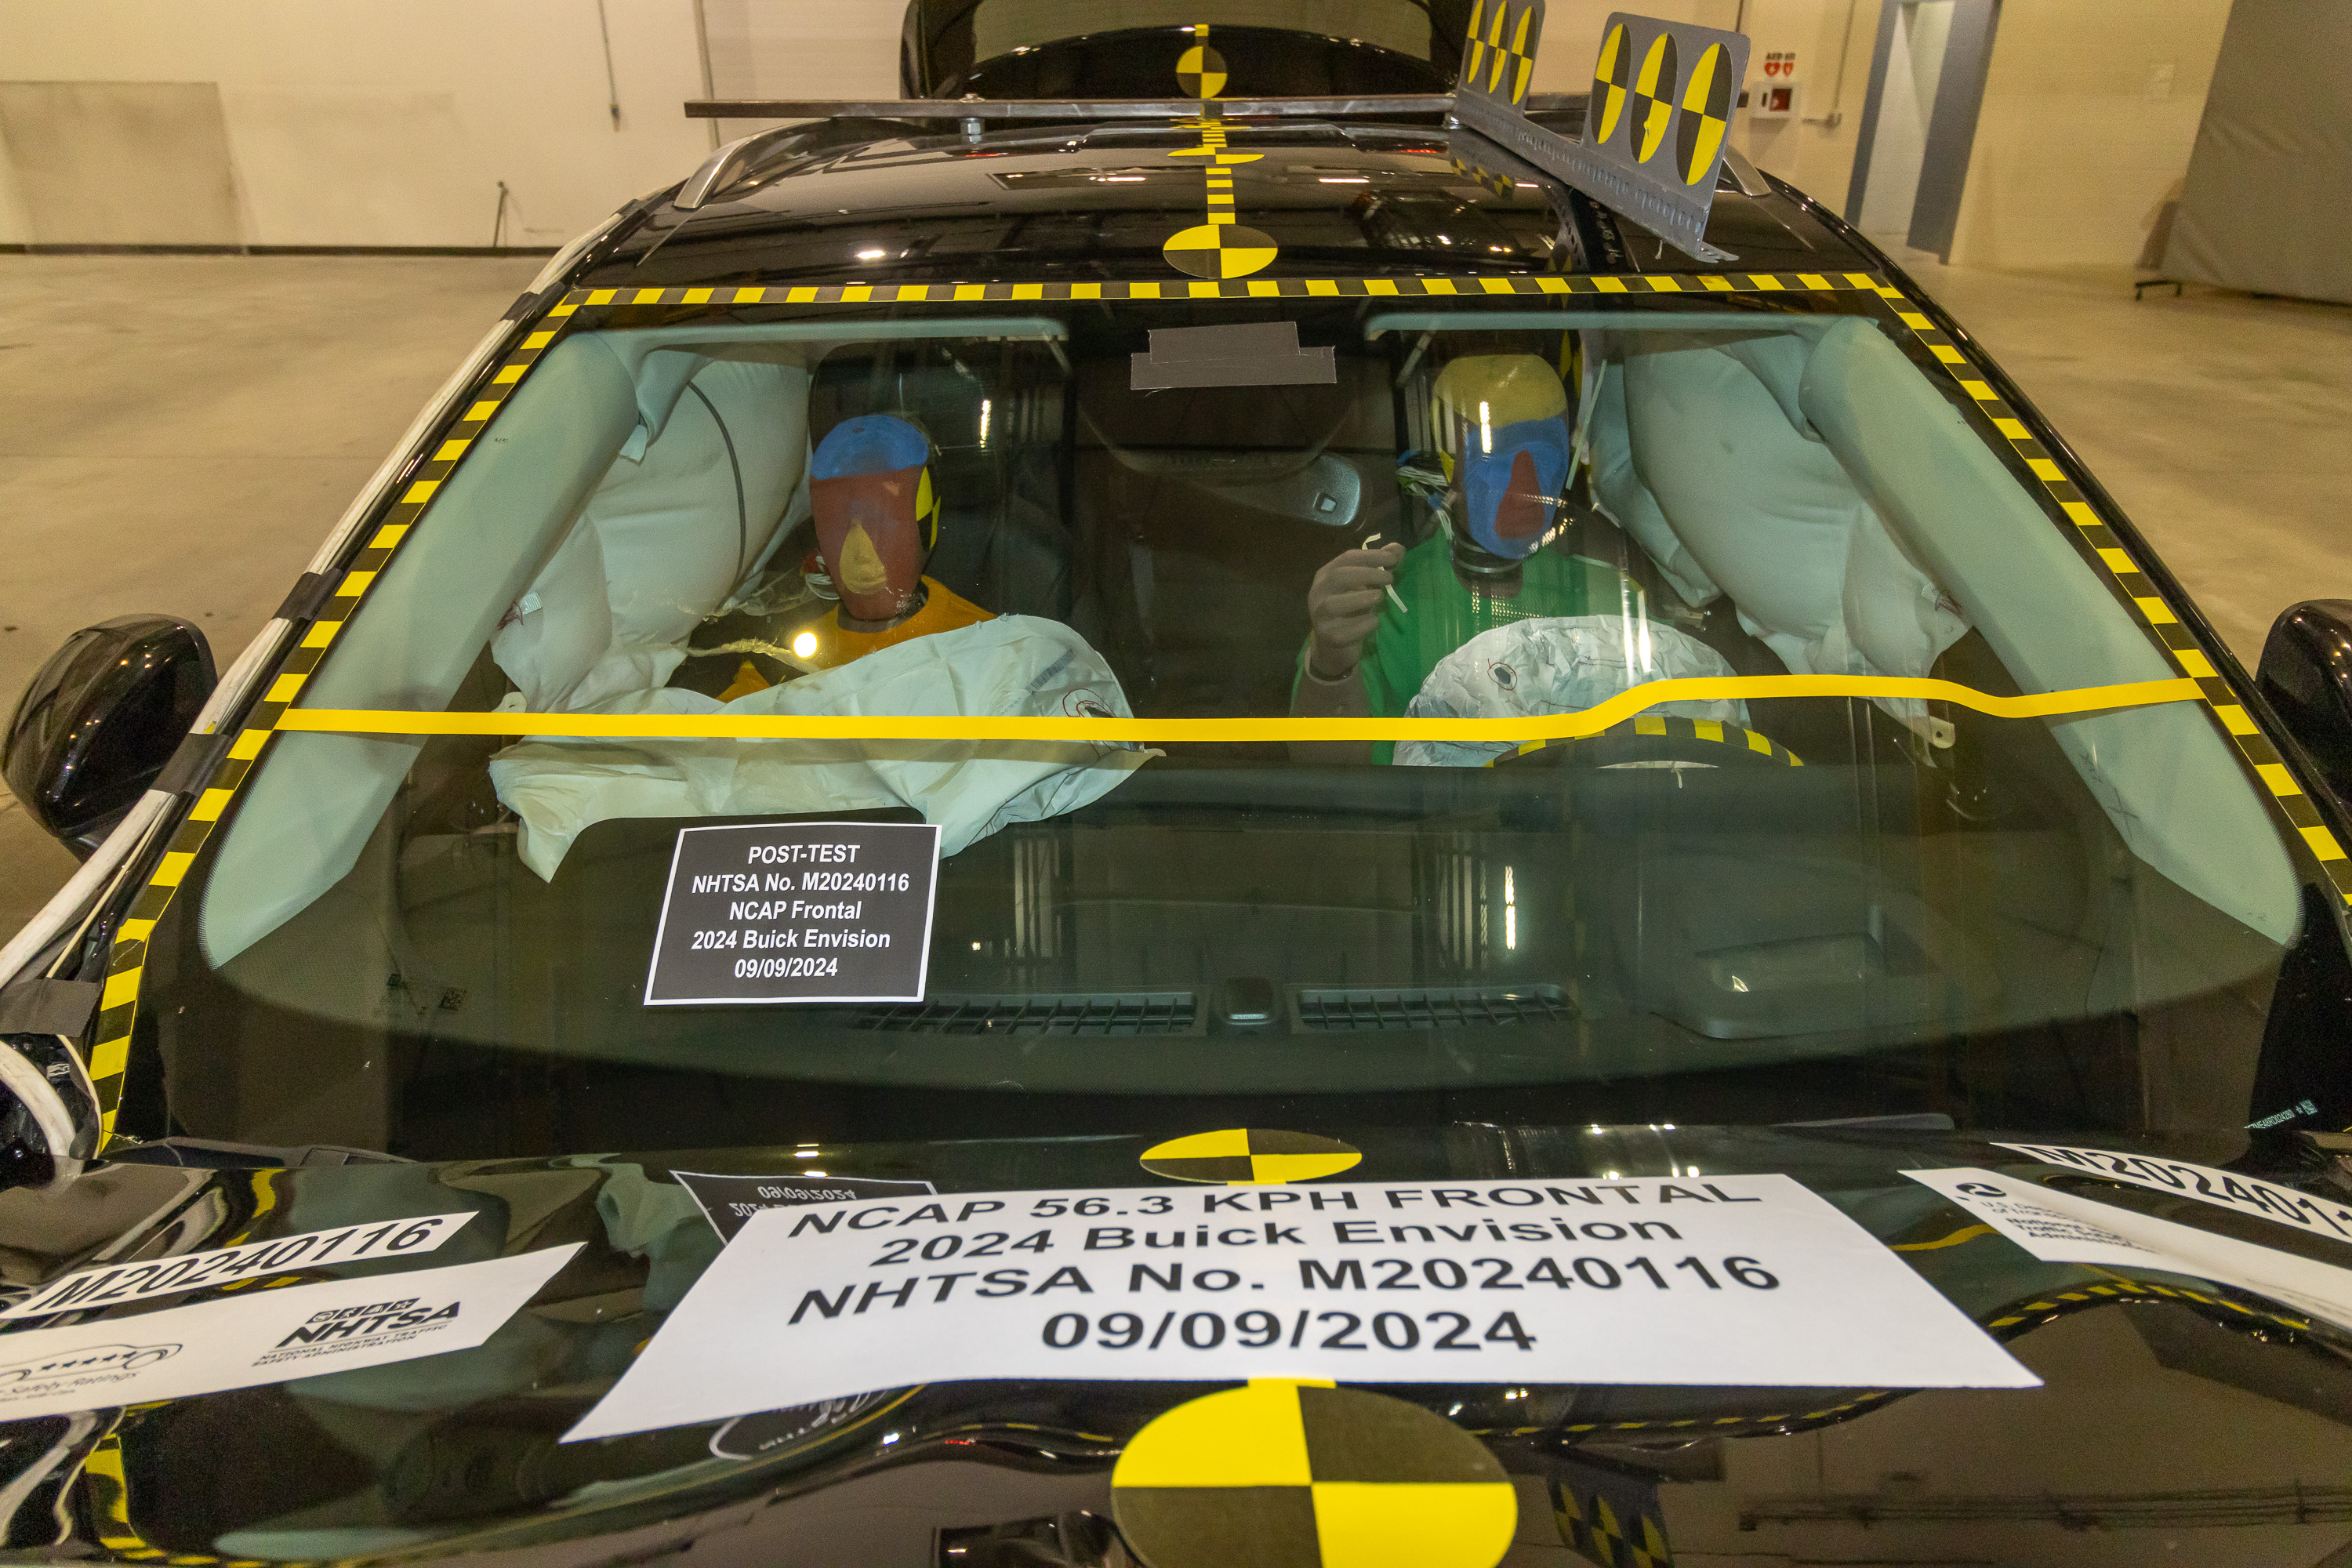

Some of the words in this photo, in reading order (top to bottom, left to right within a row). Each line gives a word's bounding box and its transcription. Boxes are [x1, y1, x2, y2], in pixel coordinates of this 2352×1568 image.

[748, 844, 861, 864] POST-TEST
[691, 873, 760, 894] NHTSA
[765, 873, 795, 892] No.
[802, 872, 909, 891] M20240116
[729, 901, 786, 920] NCAP
[791, 900, 862, 920] Frontal
[691, 930, 737, 950] 2024
[742, 929, 798, 949] Buick
[804, 928, 891, 949] Envision
[734, 957, 838, 978] 09/09/2024
[787, 1200, 1006, 1238] NCAP
[1029, 1195, 1174, 1218] 56.3
[1203, 1191, 1359, 1214] KPH
[1385, 1183, 1763, 1209] FRONTAL
[868, 1229, 1055, 1268] 2024
[1083, 1221, 1307, 1250] Buick
[1333, 1217, 1684, 1244] Envision
[28, 1218, 444, 1312] M20240116
[787, 1265, 1094, 1326] NHTSA
[1129, 1262, 1265, 1292] No.
[1298, 1255, 1780, 1291] M20240116
[274, 1301, 461, 1349] NHTSA
[1041, 1309, 1537, 1351] 09/09/2024
[260, 1347, 323, 1361] NATIONAL
